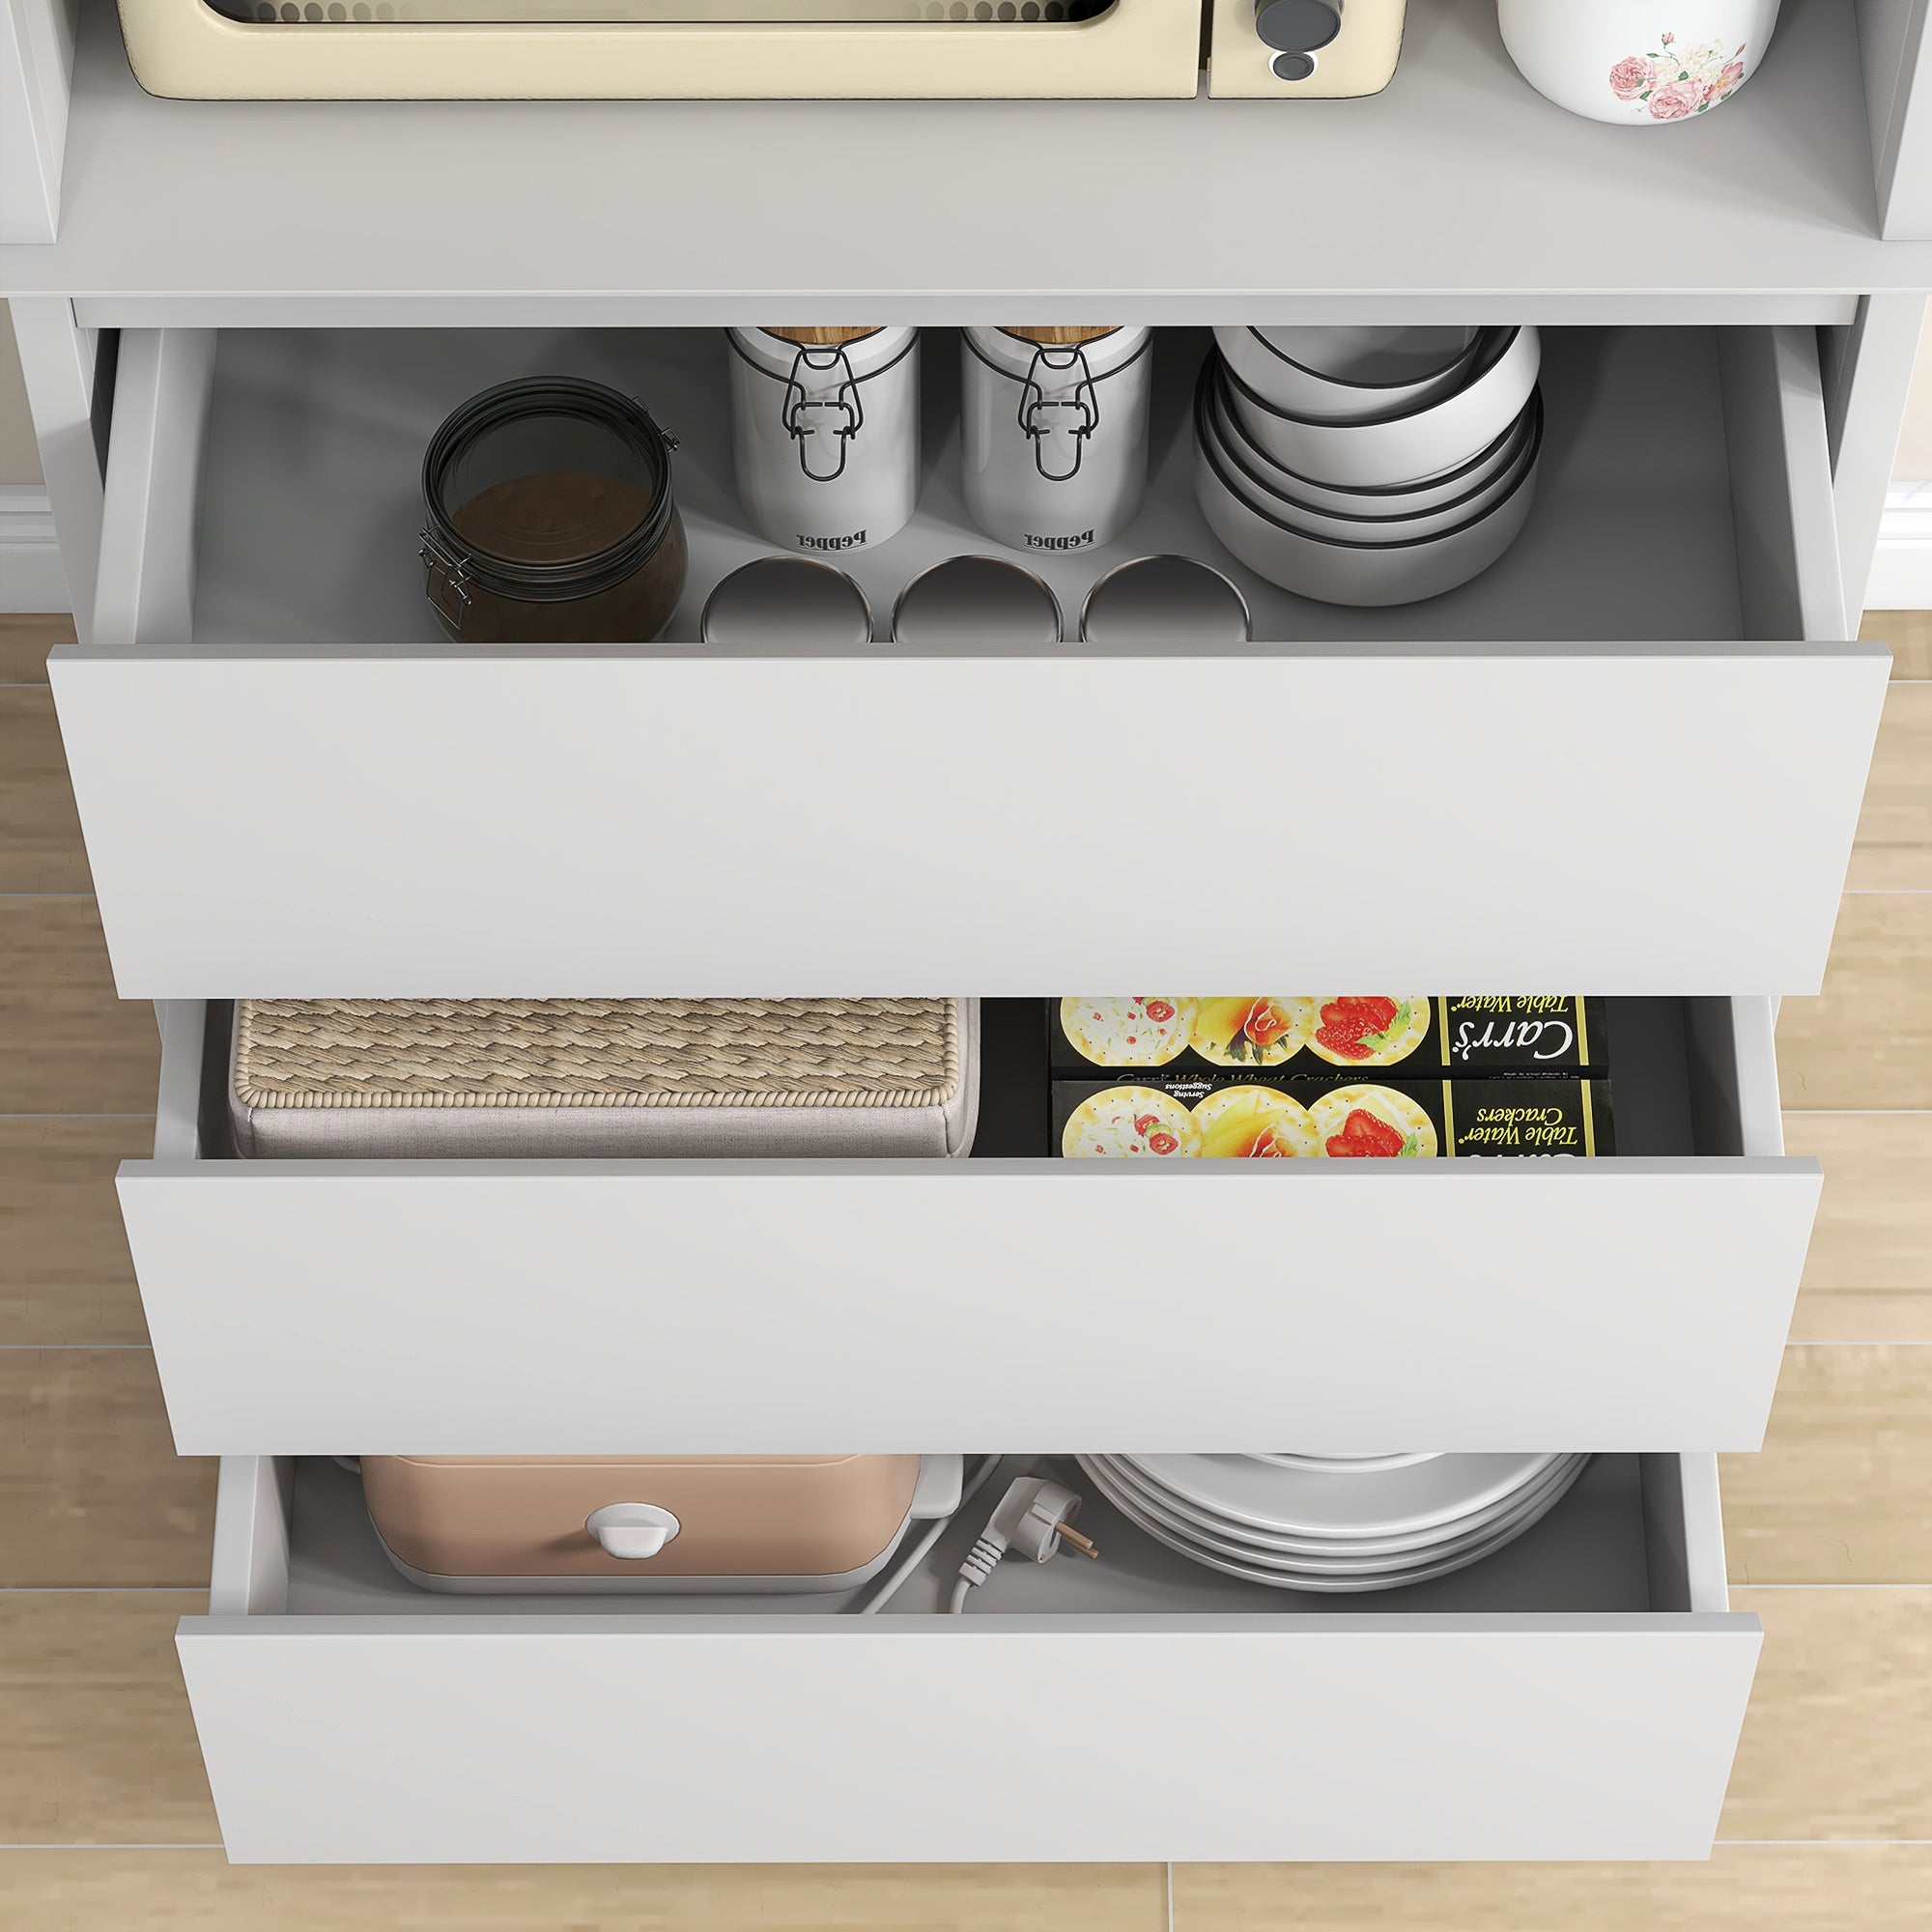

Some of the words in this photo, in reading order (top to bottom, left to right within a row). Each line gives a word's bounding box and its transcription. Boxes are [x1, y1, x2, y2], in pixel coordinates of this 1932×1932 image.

[1457, 996, 1513, 1013] Water
[1516, 996, 1569, 1013] Table
[1453, 1020, 1574, 1061] Carr's
[1164, 1081, 1212, 1091] Suggestions
[1173, 1090, 1205, 1098] Serving
[1476, 1107, 1563, 1127] Crackers
[1463, 1126, 1520, 1146] Water
[1524, 1126, 1578, 1146] Table
